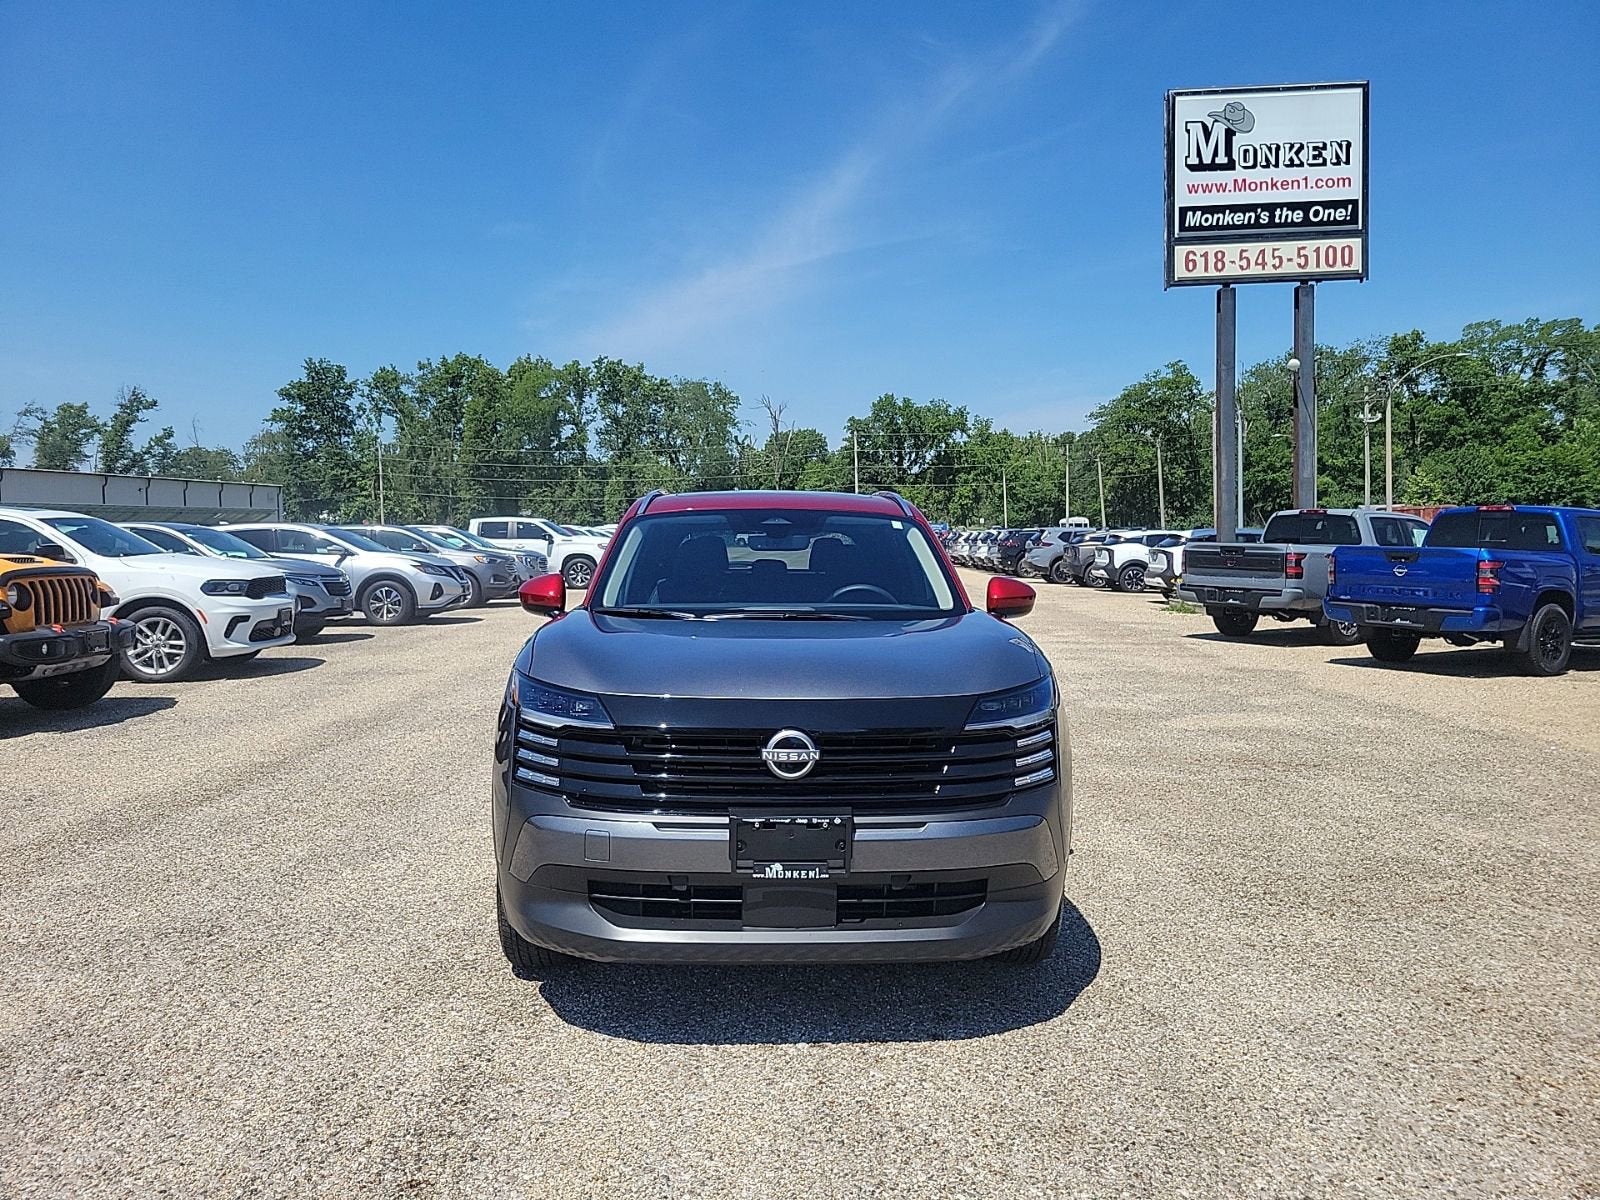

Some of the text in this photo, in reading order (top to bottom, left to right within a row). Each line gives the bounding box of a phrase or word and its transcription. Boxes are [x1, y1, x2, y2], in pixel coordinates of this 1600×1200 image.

[1185, 120, 1353, 172] MONKEN
[1187, 175, 1352, 194] www.Monken1.com
[1185, 204, 1353, 227] Monken's the One!
[1184, 244, 1354, 273] 618-545-5100
[762, 751, 819, 761] NISSAN
